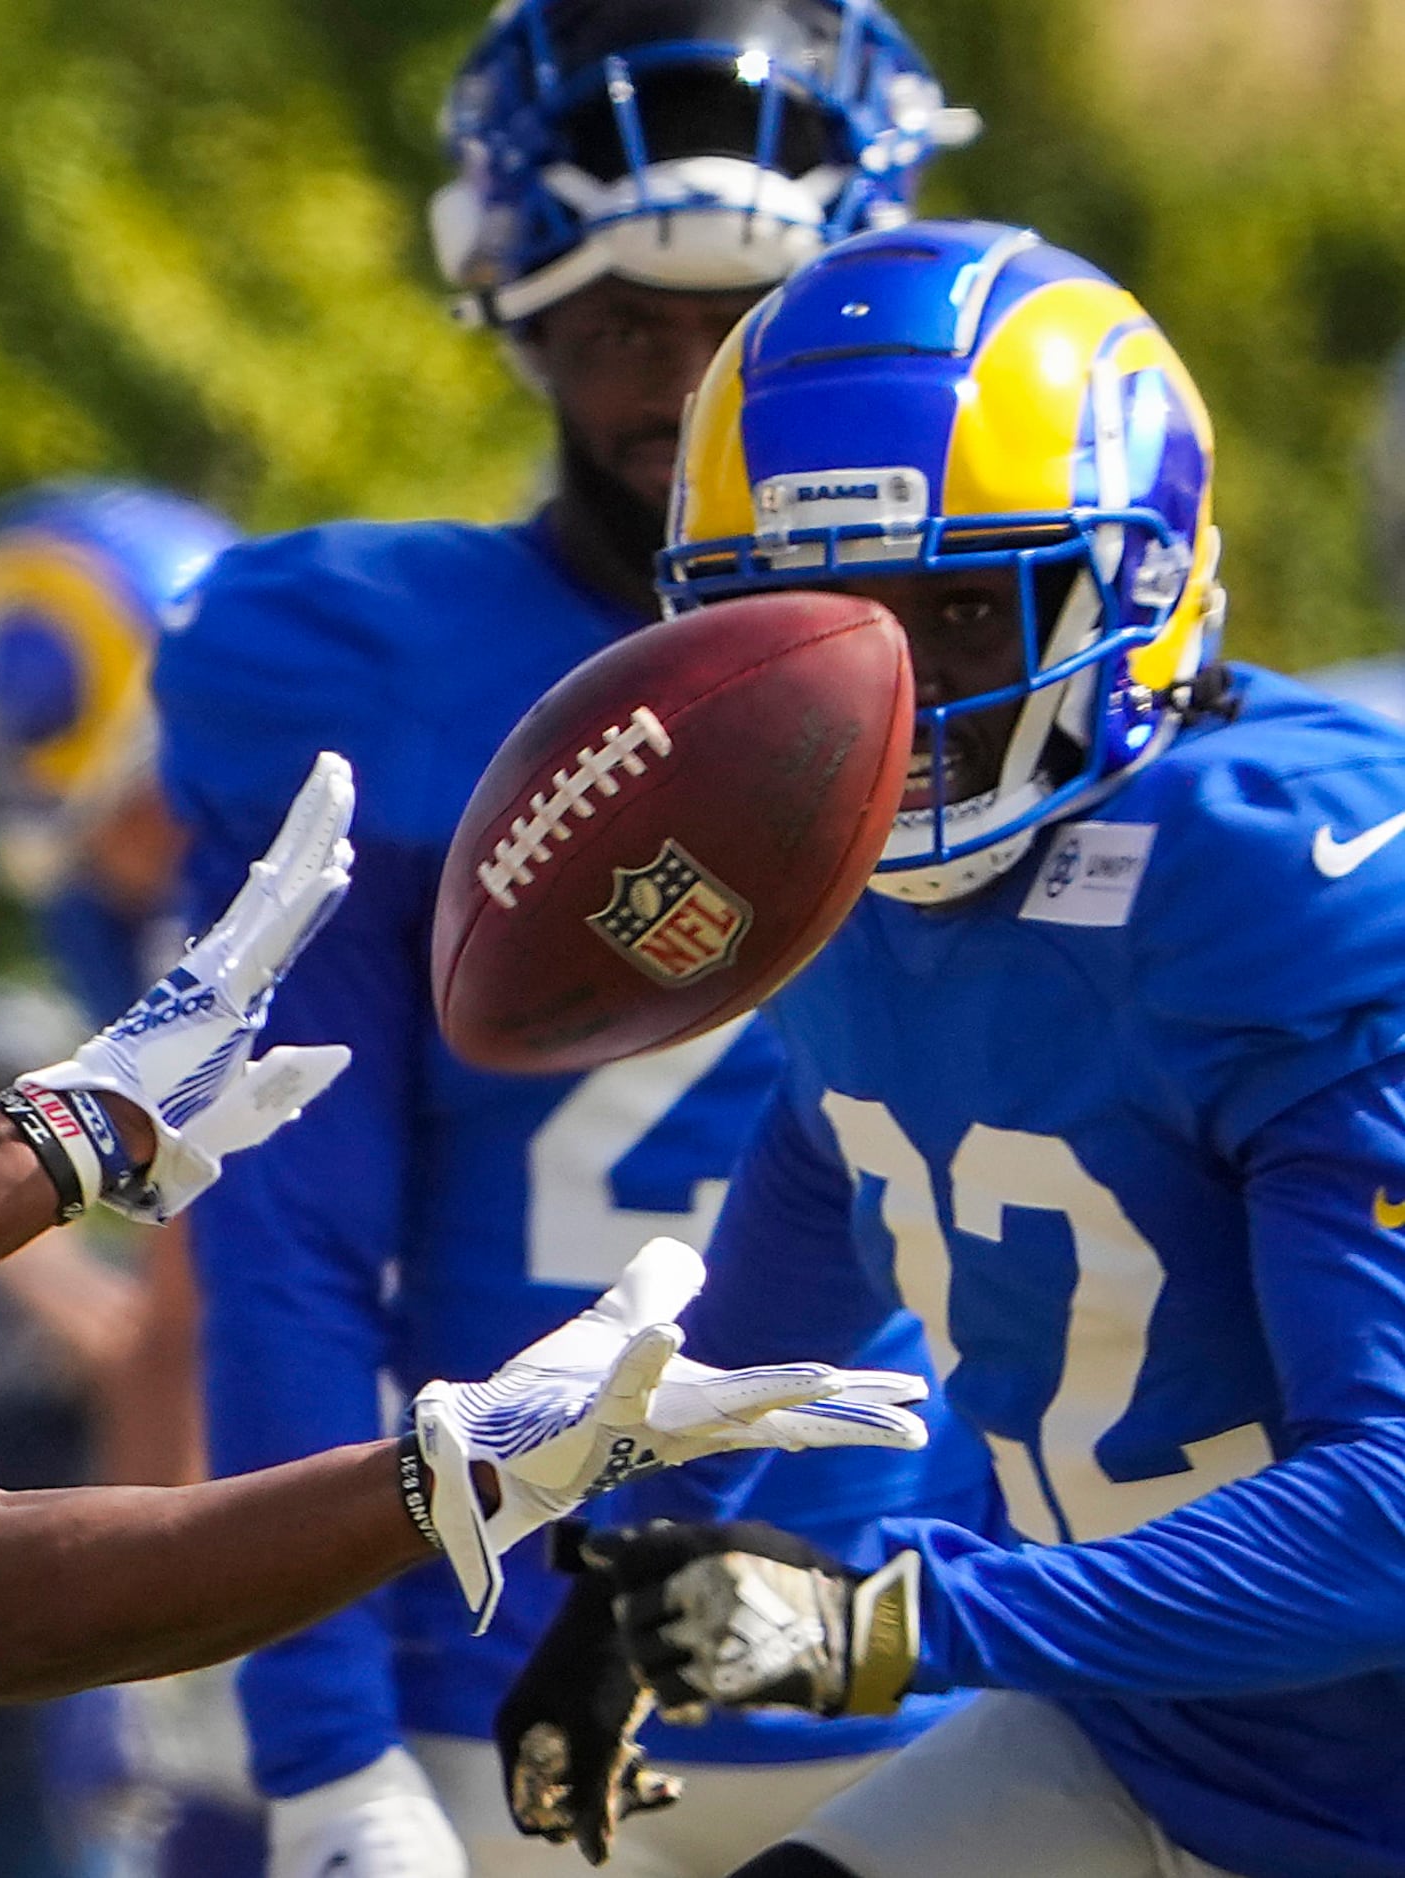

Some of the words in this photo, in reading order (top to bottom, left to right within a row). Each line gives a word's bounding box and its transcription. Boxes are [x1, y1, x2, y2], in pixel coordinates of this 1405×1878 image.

[797, 484, 878, 501] RAMS
[641, 896, 736, 975] NFL
[109, 986, 216, 1040] adidas
